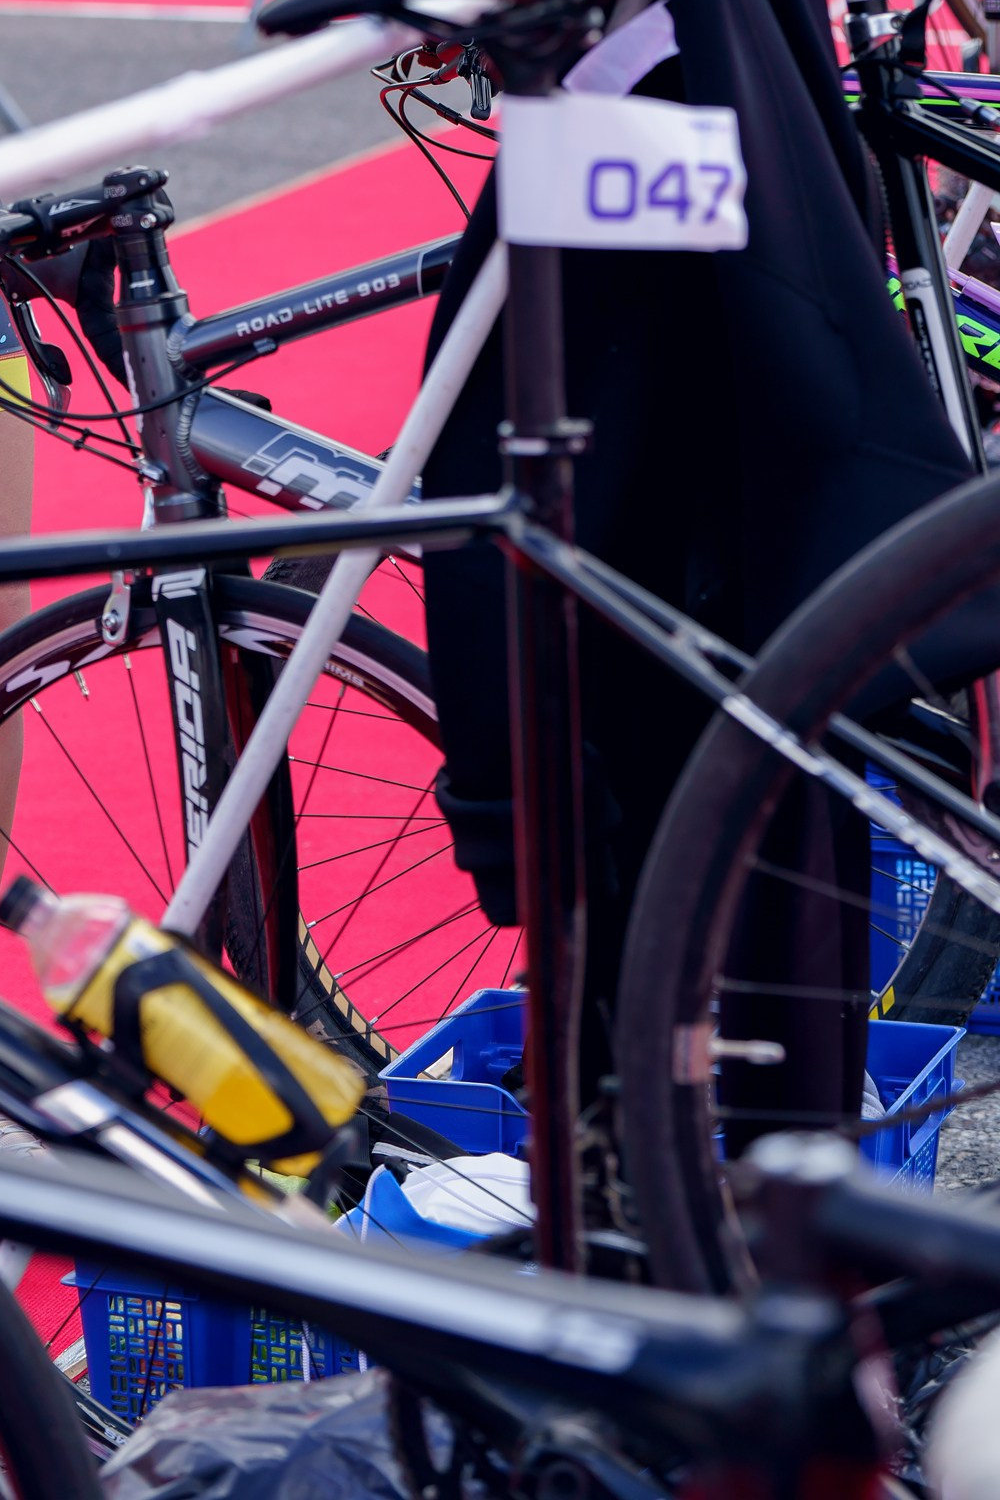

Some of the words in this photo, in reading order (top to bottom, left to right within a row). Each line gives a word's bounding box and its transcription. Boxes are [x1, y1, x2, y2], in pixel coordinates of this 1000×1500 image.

[587, 160, 732, 225] 047
[235, 307, 293, 337] ROAD
[303, 289, 349, 315] LITE
[357, 272, 401, 298] 903
[166, 617, 209, 866] ERIDA
